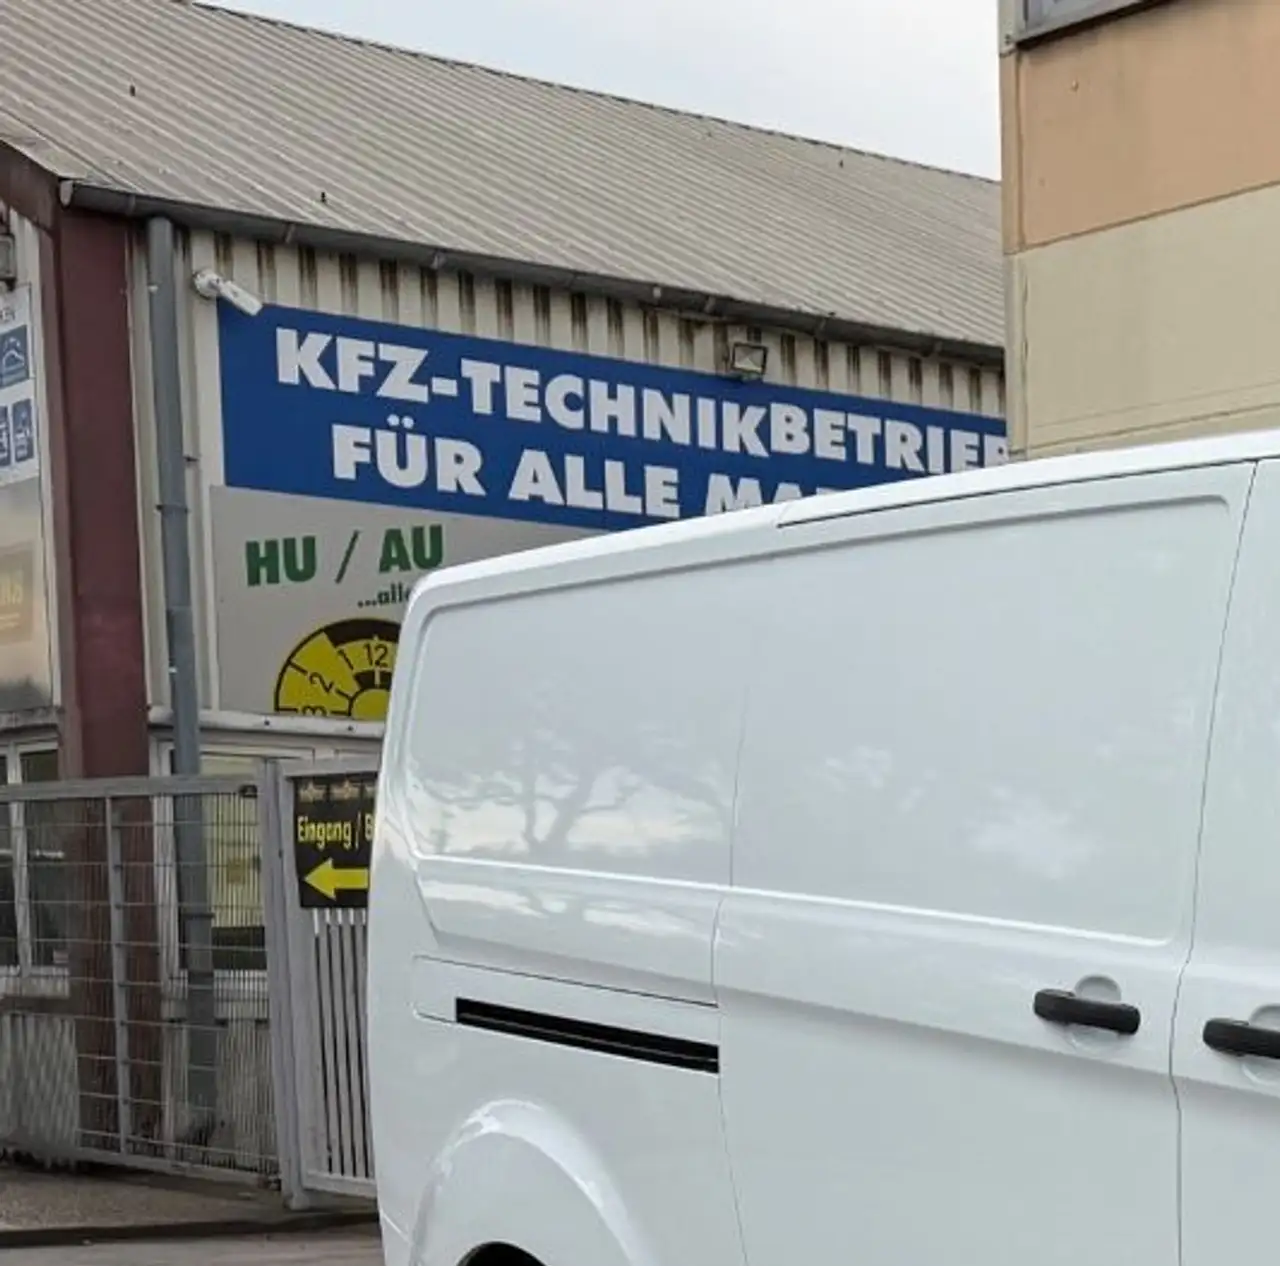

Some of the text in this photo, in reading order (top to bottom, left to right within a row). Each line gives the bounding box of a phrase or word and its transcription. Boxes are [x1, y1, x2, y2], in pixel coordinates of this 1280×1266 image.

[276, 326, 1009, 474] KFZ-TECHNIKBETRIEB
[332, 414, 486, 496] FÜR
[507, 448, 682, 519] ALLE
[246, 535, 317, 586] HU
[379, 524, 444, 574] AU
[298, 815, 352, 850] Eingang
